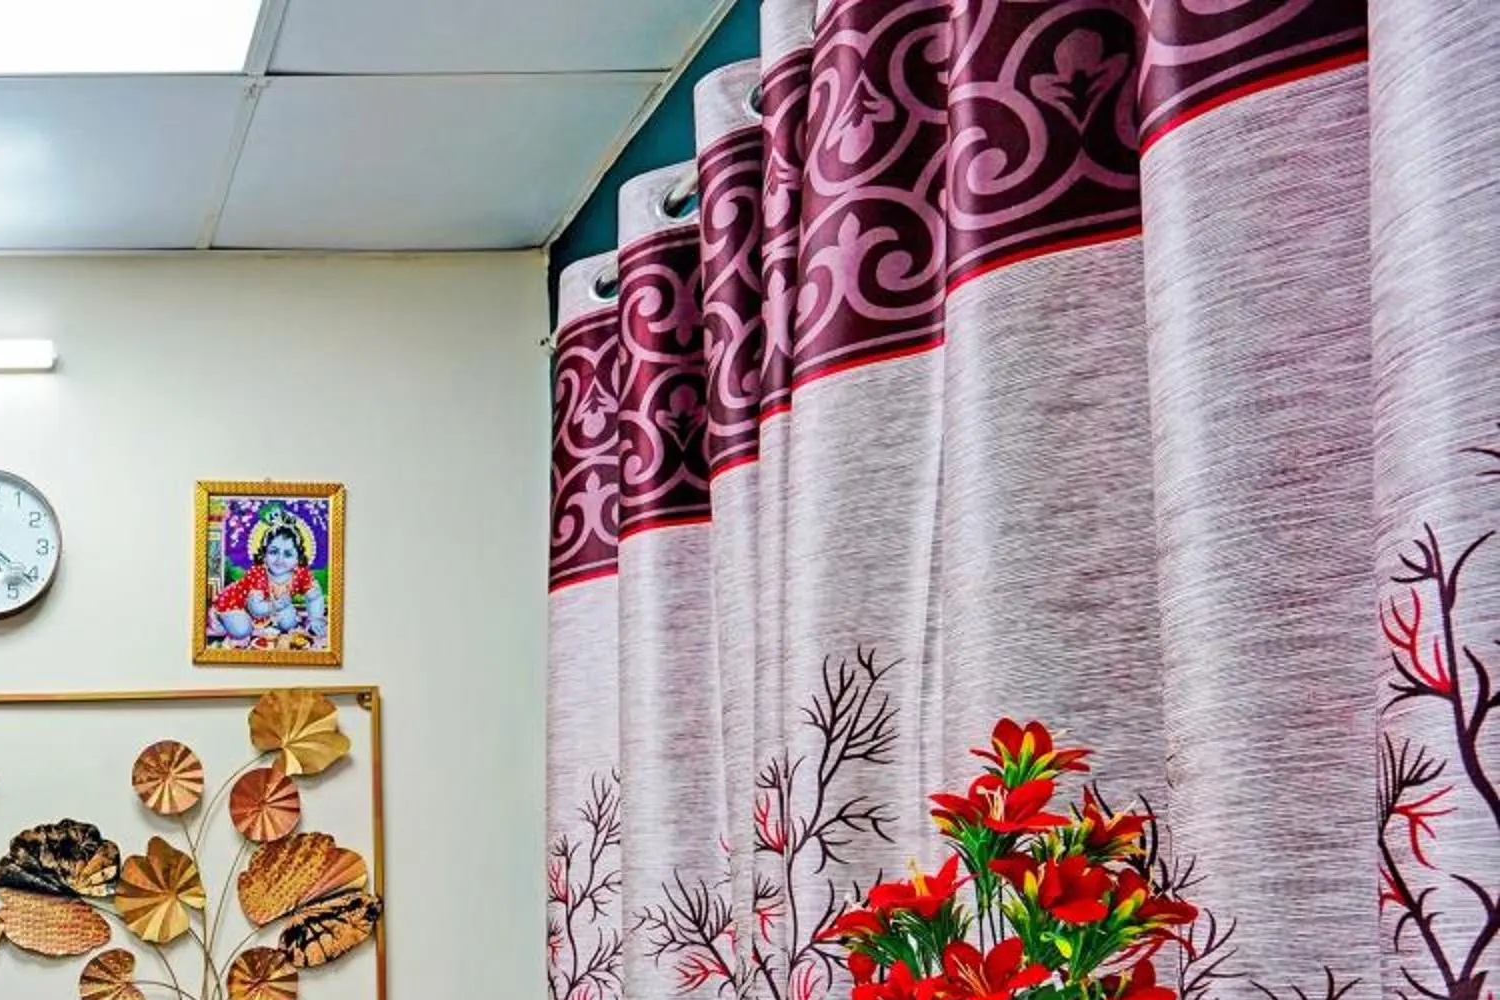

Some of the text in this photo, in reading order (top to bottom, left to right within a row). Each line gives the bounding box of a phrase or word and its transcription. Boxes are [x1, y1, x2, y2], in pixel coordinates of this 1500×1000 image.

[15, 491, 21, 507] 1
[29, 511, 41, 528] 2
[36, 539, 49, 555] 3
[25, 566, 39, 583] 4
[7, 583, 19, 600] 5
